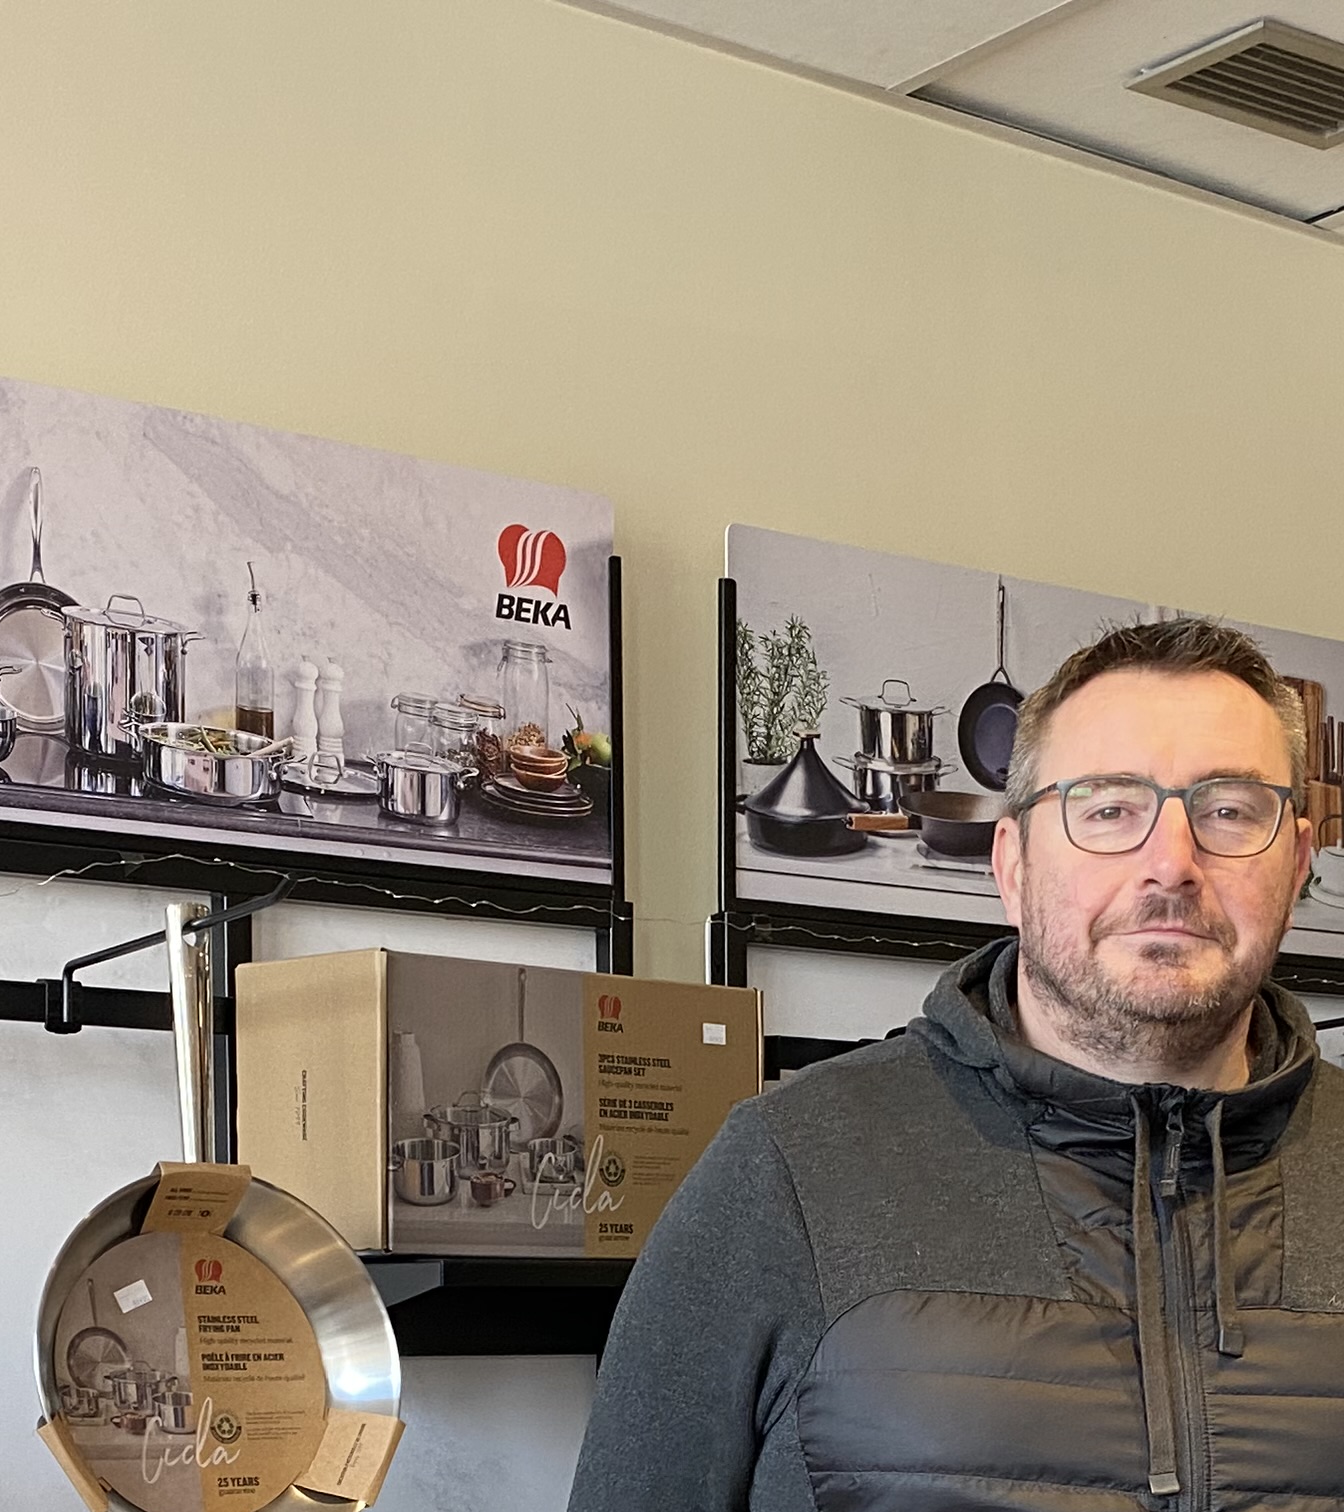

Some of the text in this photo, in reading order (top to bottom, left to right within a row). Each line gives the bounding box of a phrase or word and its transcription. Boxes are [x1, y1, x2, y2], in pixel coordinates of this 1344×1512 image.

[496, 593, 571, 630] BEKA
[598, 1021, 623, 1033] BEKA
[652, 1058, 672, 1068] STEEL
[599, 1065, 646, 1077] SAUCEPAN SET
[599, 1223, 634, 1234] 25 YEARS
[195, 1285, 226, 1296] BEKA
[198, 1315, 260, 1324] STAINLESS STEEL
[226, 1324, 241, 1333] PAN
[217, 1477, 260, 1488] 25 YEARS
